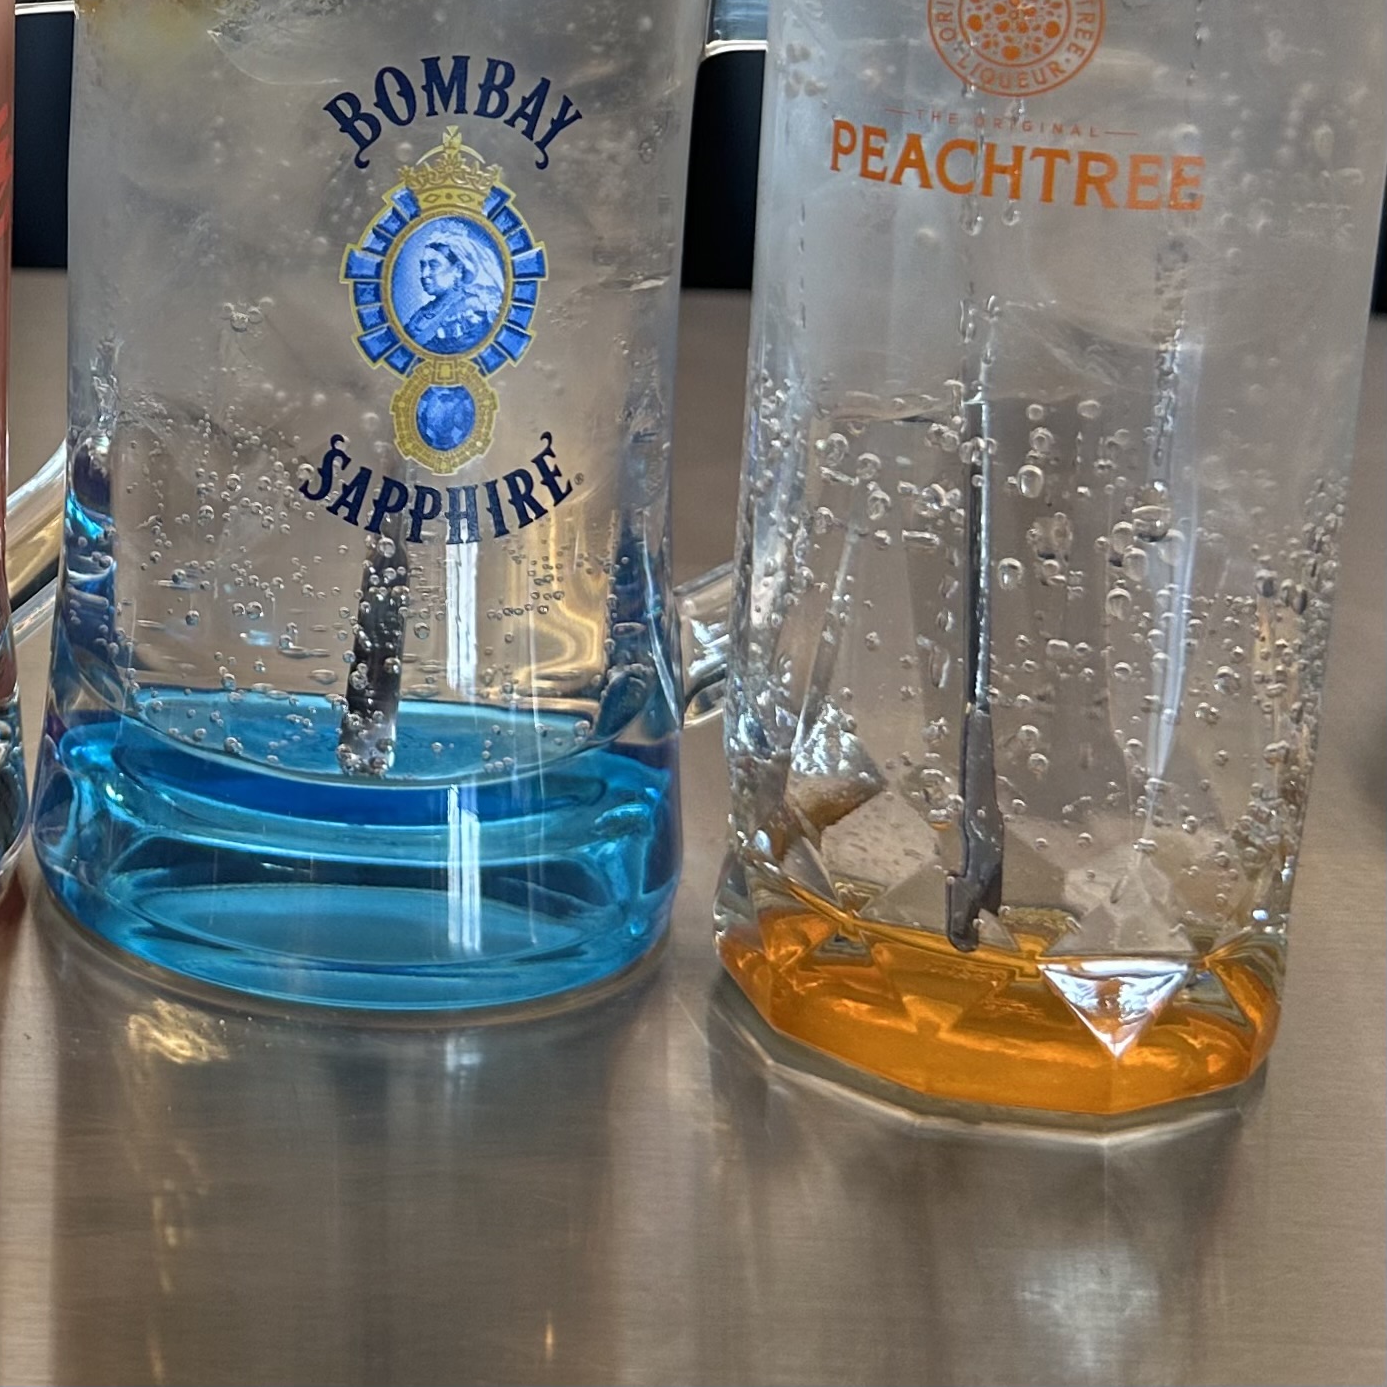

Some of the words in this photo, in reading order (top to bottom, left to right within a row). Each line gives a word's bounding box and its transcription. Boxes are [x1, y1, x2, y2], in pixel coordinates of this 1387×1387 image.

[322, 55, 583, 170] BOMBAY
[955, 52, 1068, 90] LIQUEUR
[830, 118, 1205, 211] PEACHTREE
[916, 109, 958, 126] THE
[974, 116, 1100, 139] ORIGINAL
[298, 431, 574, 546] SAPPHIRE
